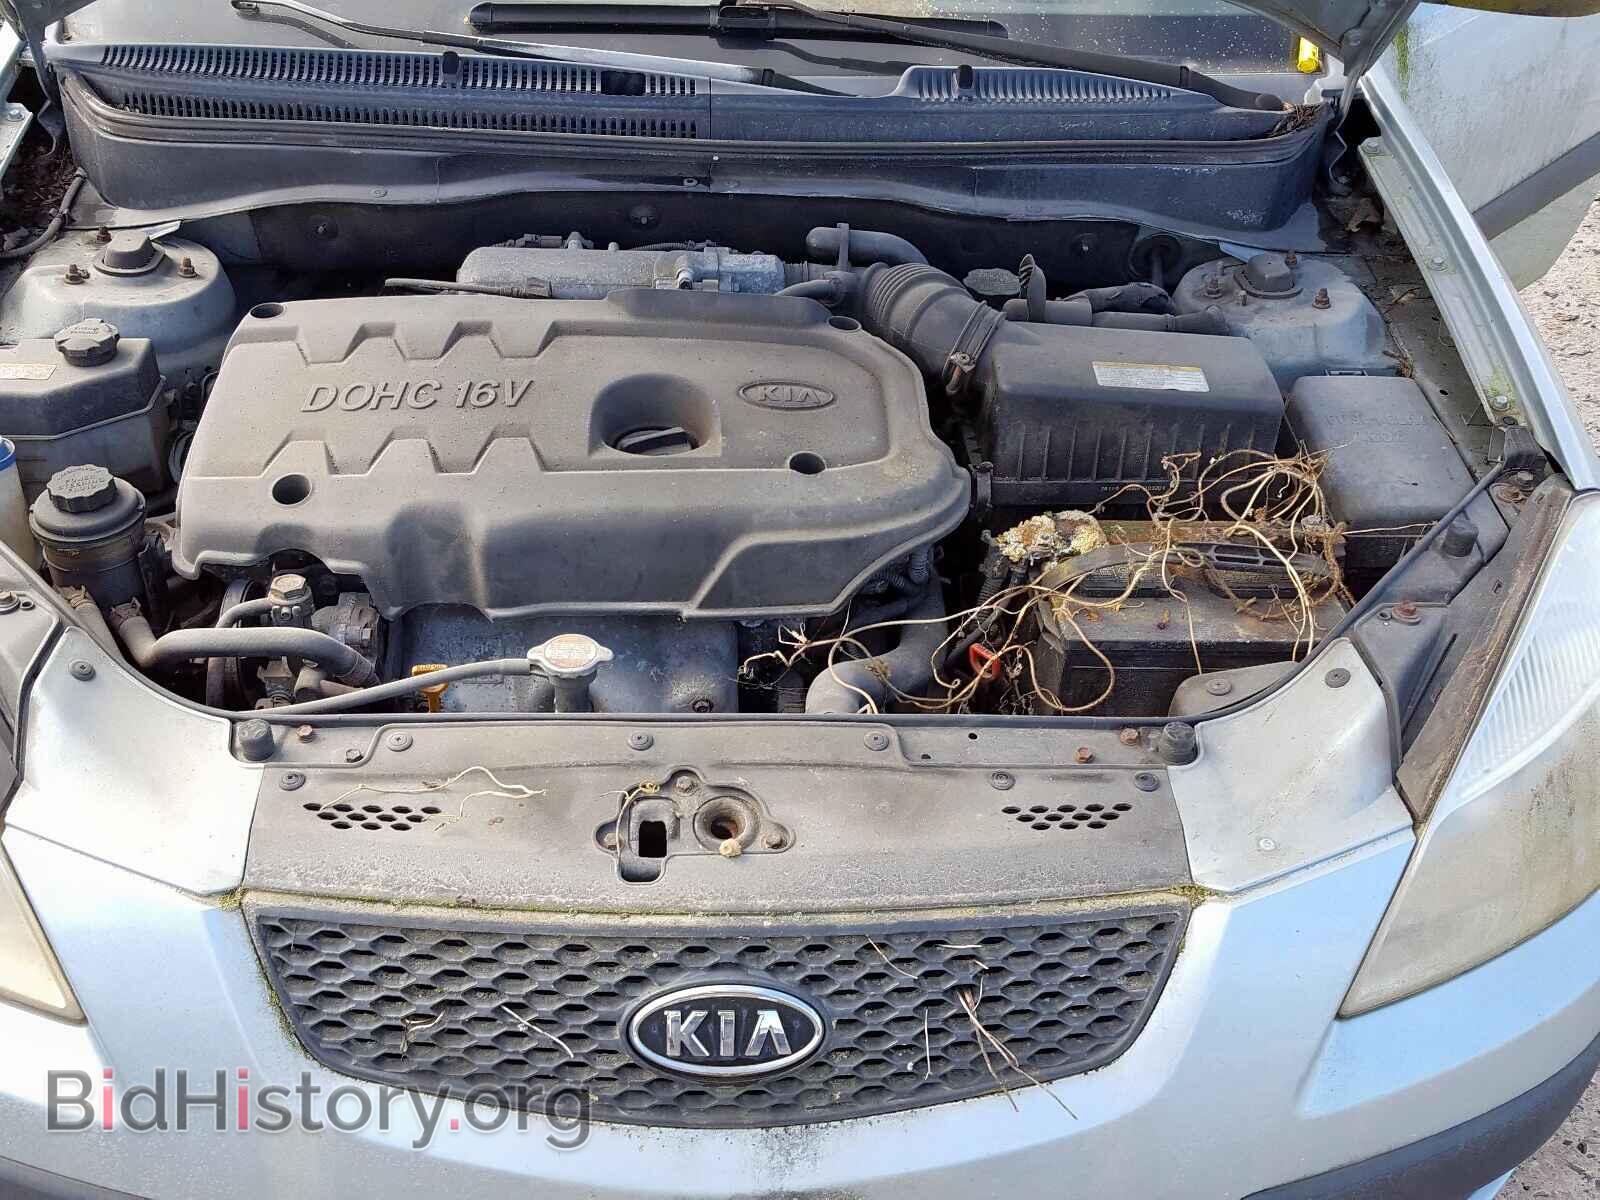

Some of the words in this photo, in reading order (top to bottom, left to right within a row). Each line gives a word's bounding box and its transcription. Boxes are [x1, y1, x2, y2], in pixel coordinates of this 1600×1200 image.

[300, 379, 442, 412] DOHC
[456, 378, 534, 408] 16V
[757, 385, 821, 404] KIA
[664, 1009, 793, 1056] KIA
